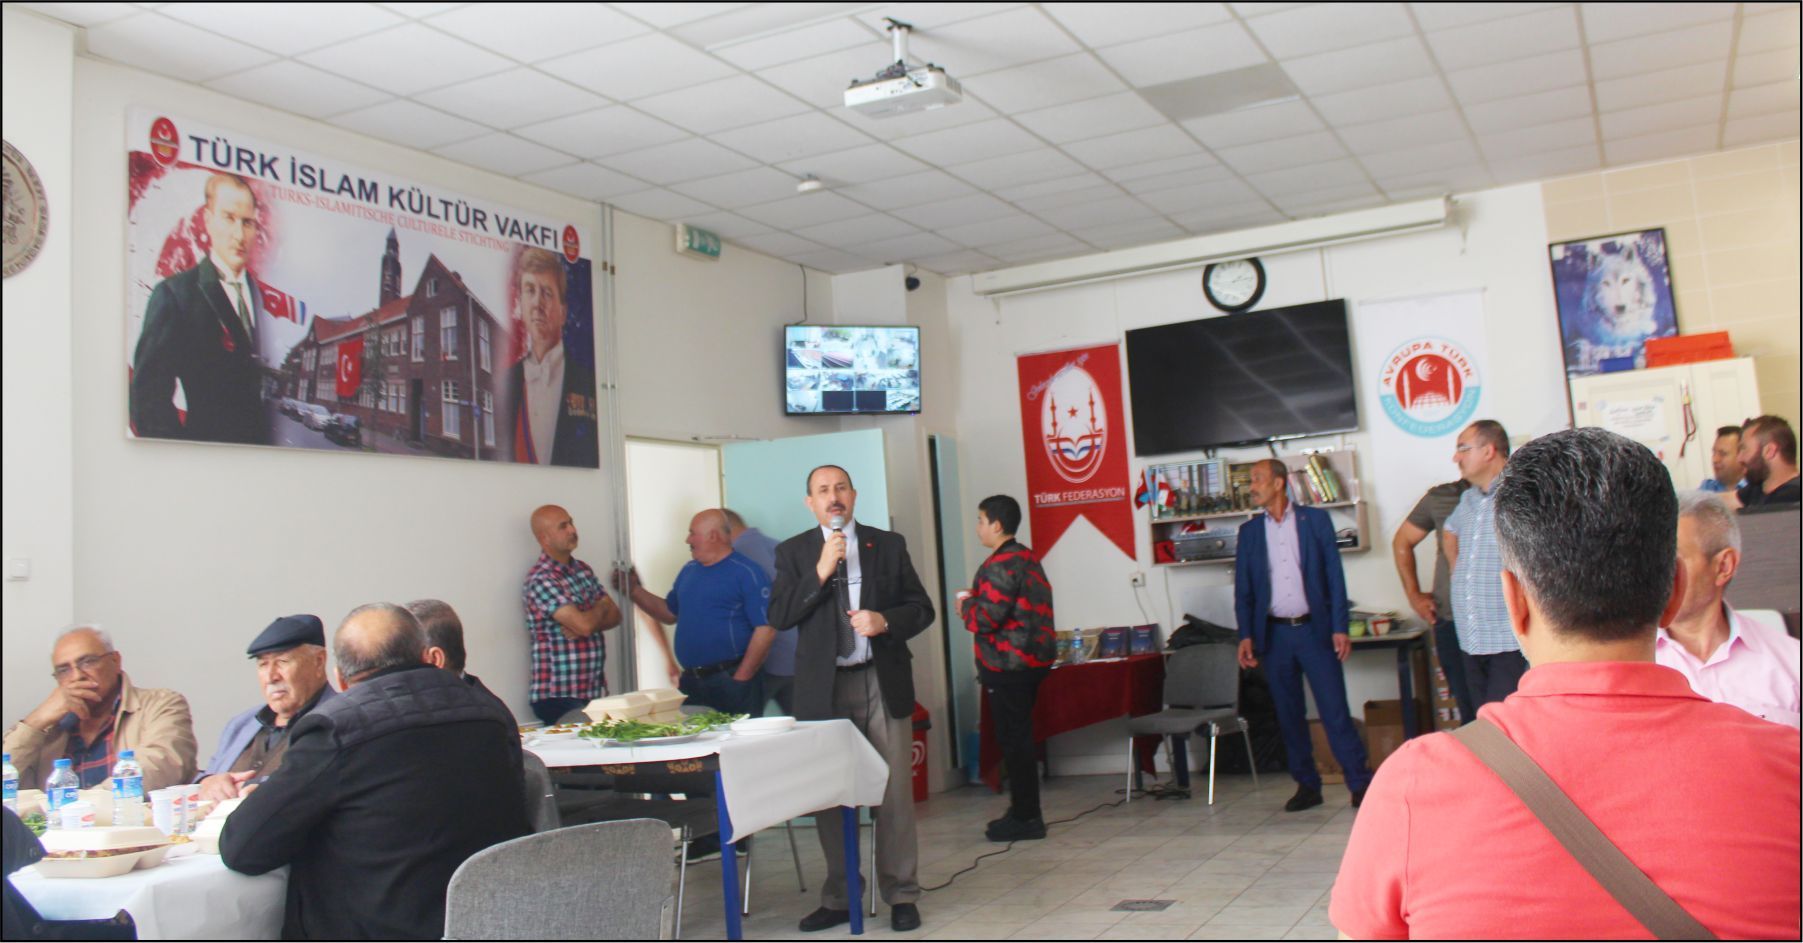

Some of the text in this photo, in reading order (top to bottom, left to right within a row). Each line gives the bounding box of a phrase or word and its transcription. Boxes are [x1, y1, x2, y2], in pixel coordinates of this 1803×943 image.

[188, 134, 558, 249] TÜRK İSLAM KÜLTÜR VAKFI
[397, 215, 456, 241] CULTURELE
[458, 230, 510, 252] STICHTING
[1383, 342, 1432, 386] AVRUPA
[1034, 487, 1126, 504] TÜRK FEDERASYON
